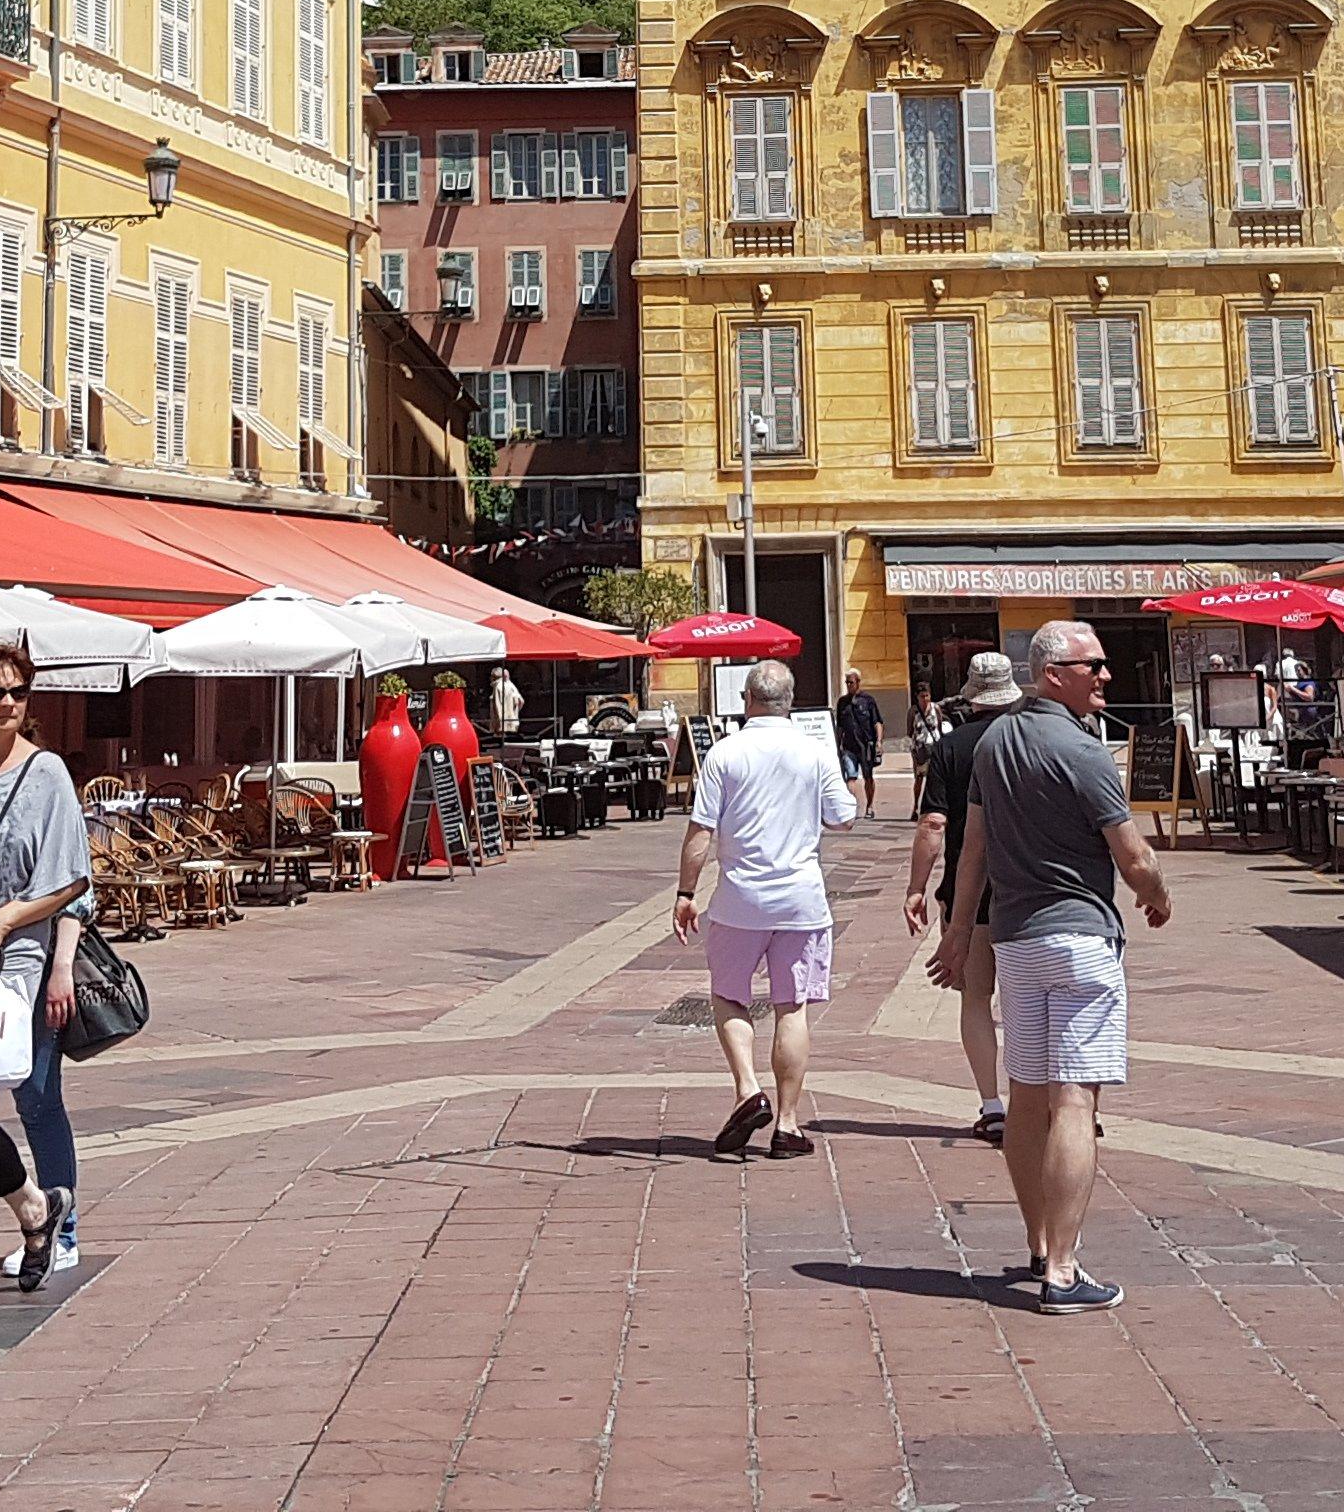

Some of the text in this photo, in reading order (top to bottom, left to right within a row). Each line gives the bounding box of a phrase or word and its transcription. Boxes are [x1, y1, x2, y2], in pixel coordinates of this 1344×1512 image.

[888, 569, 998, 589] PEINTURES
[1132, 570, 1155, 590] ET
[1200, 589, 1294, 606] BADOIT
[691, 619, 756, 638] BADOIT
